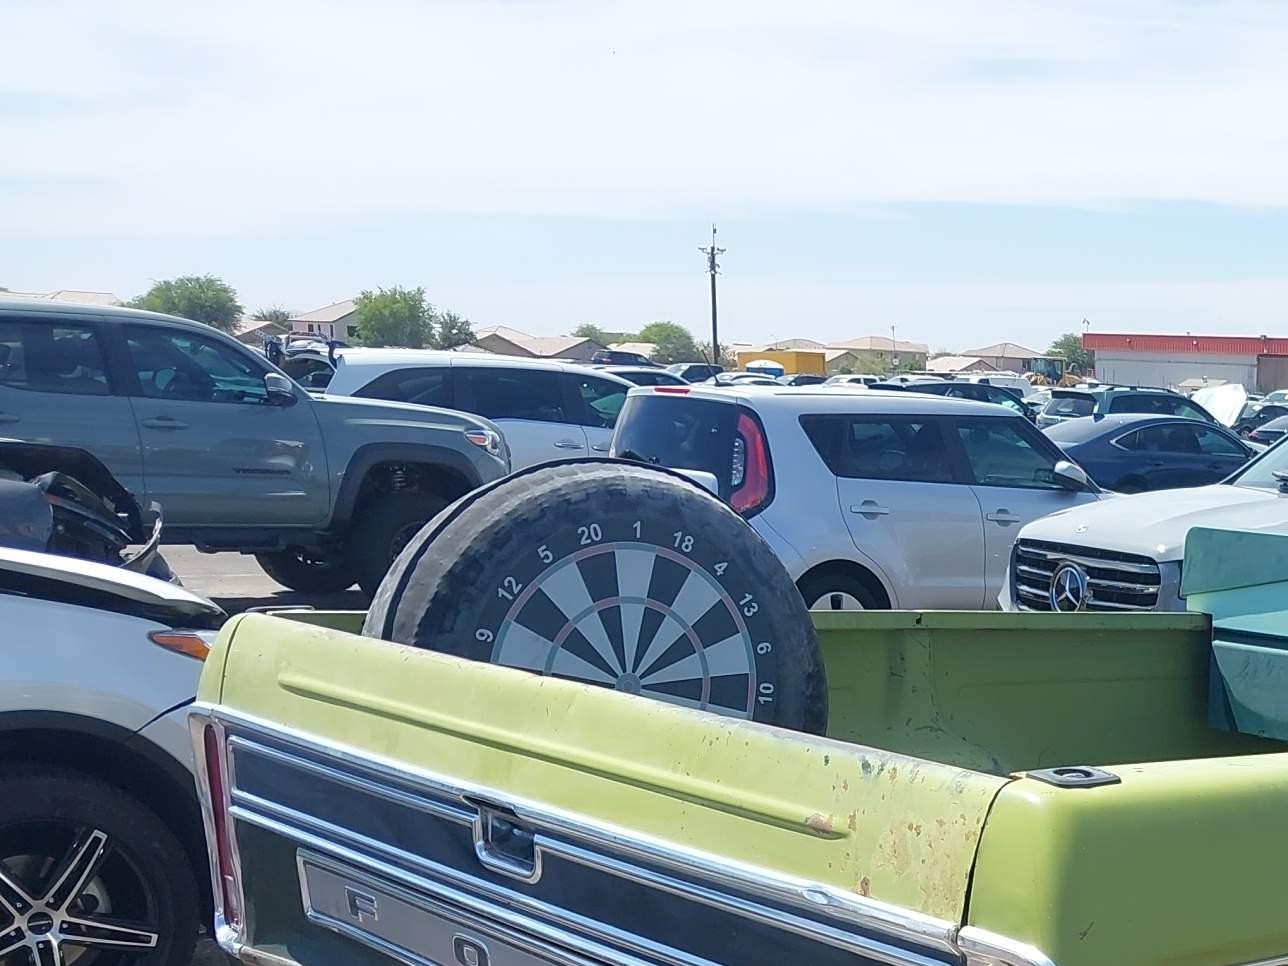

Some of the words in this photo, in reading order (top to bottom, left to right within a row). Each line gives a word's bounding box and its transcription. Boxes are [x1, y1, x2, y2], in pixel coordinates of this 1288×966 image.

[577, 523, 602, 545] 20
[632, 520, 642, 539] 1
[673, 531, 695, 553] 18
[537, 545, 553, 563] 5
[714, 561, 729, 576] 4
[497, 576, 523, 600] 12
[739, 593, 758, 617] 13
[758, 682, 774, 704] 10
